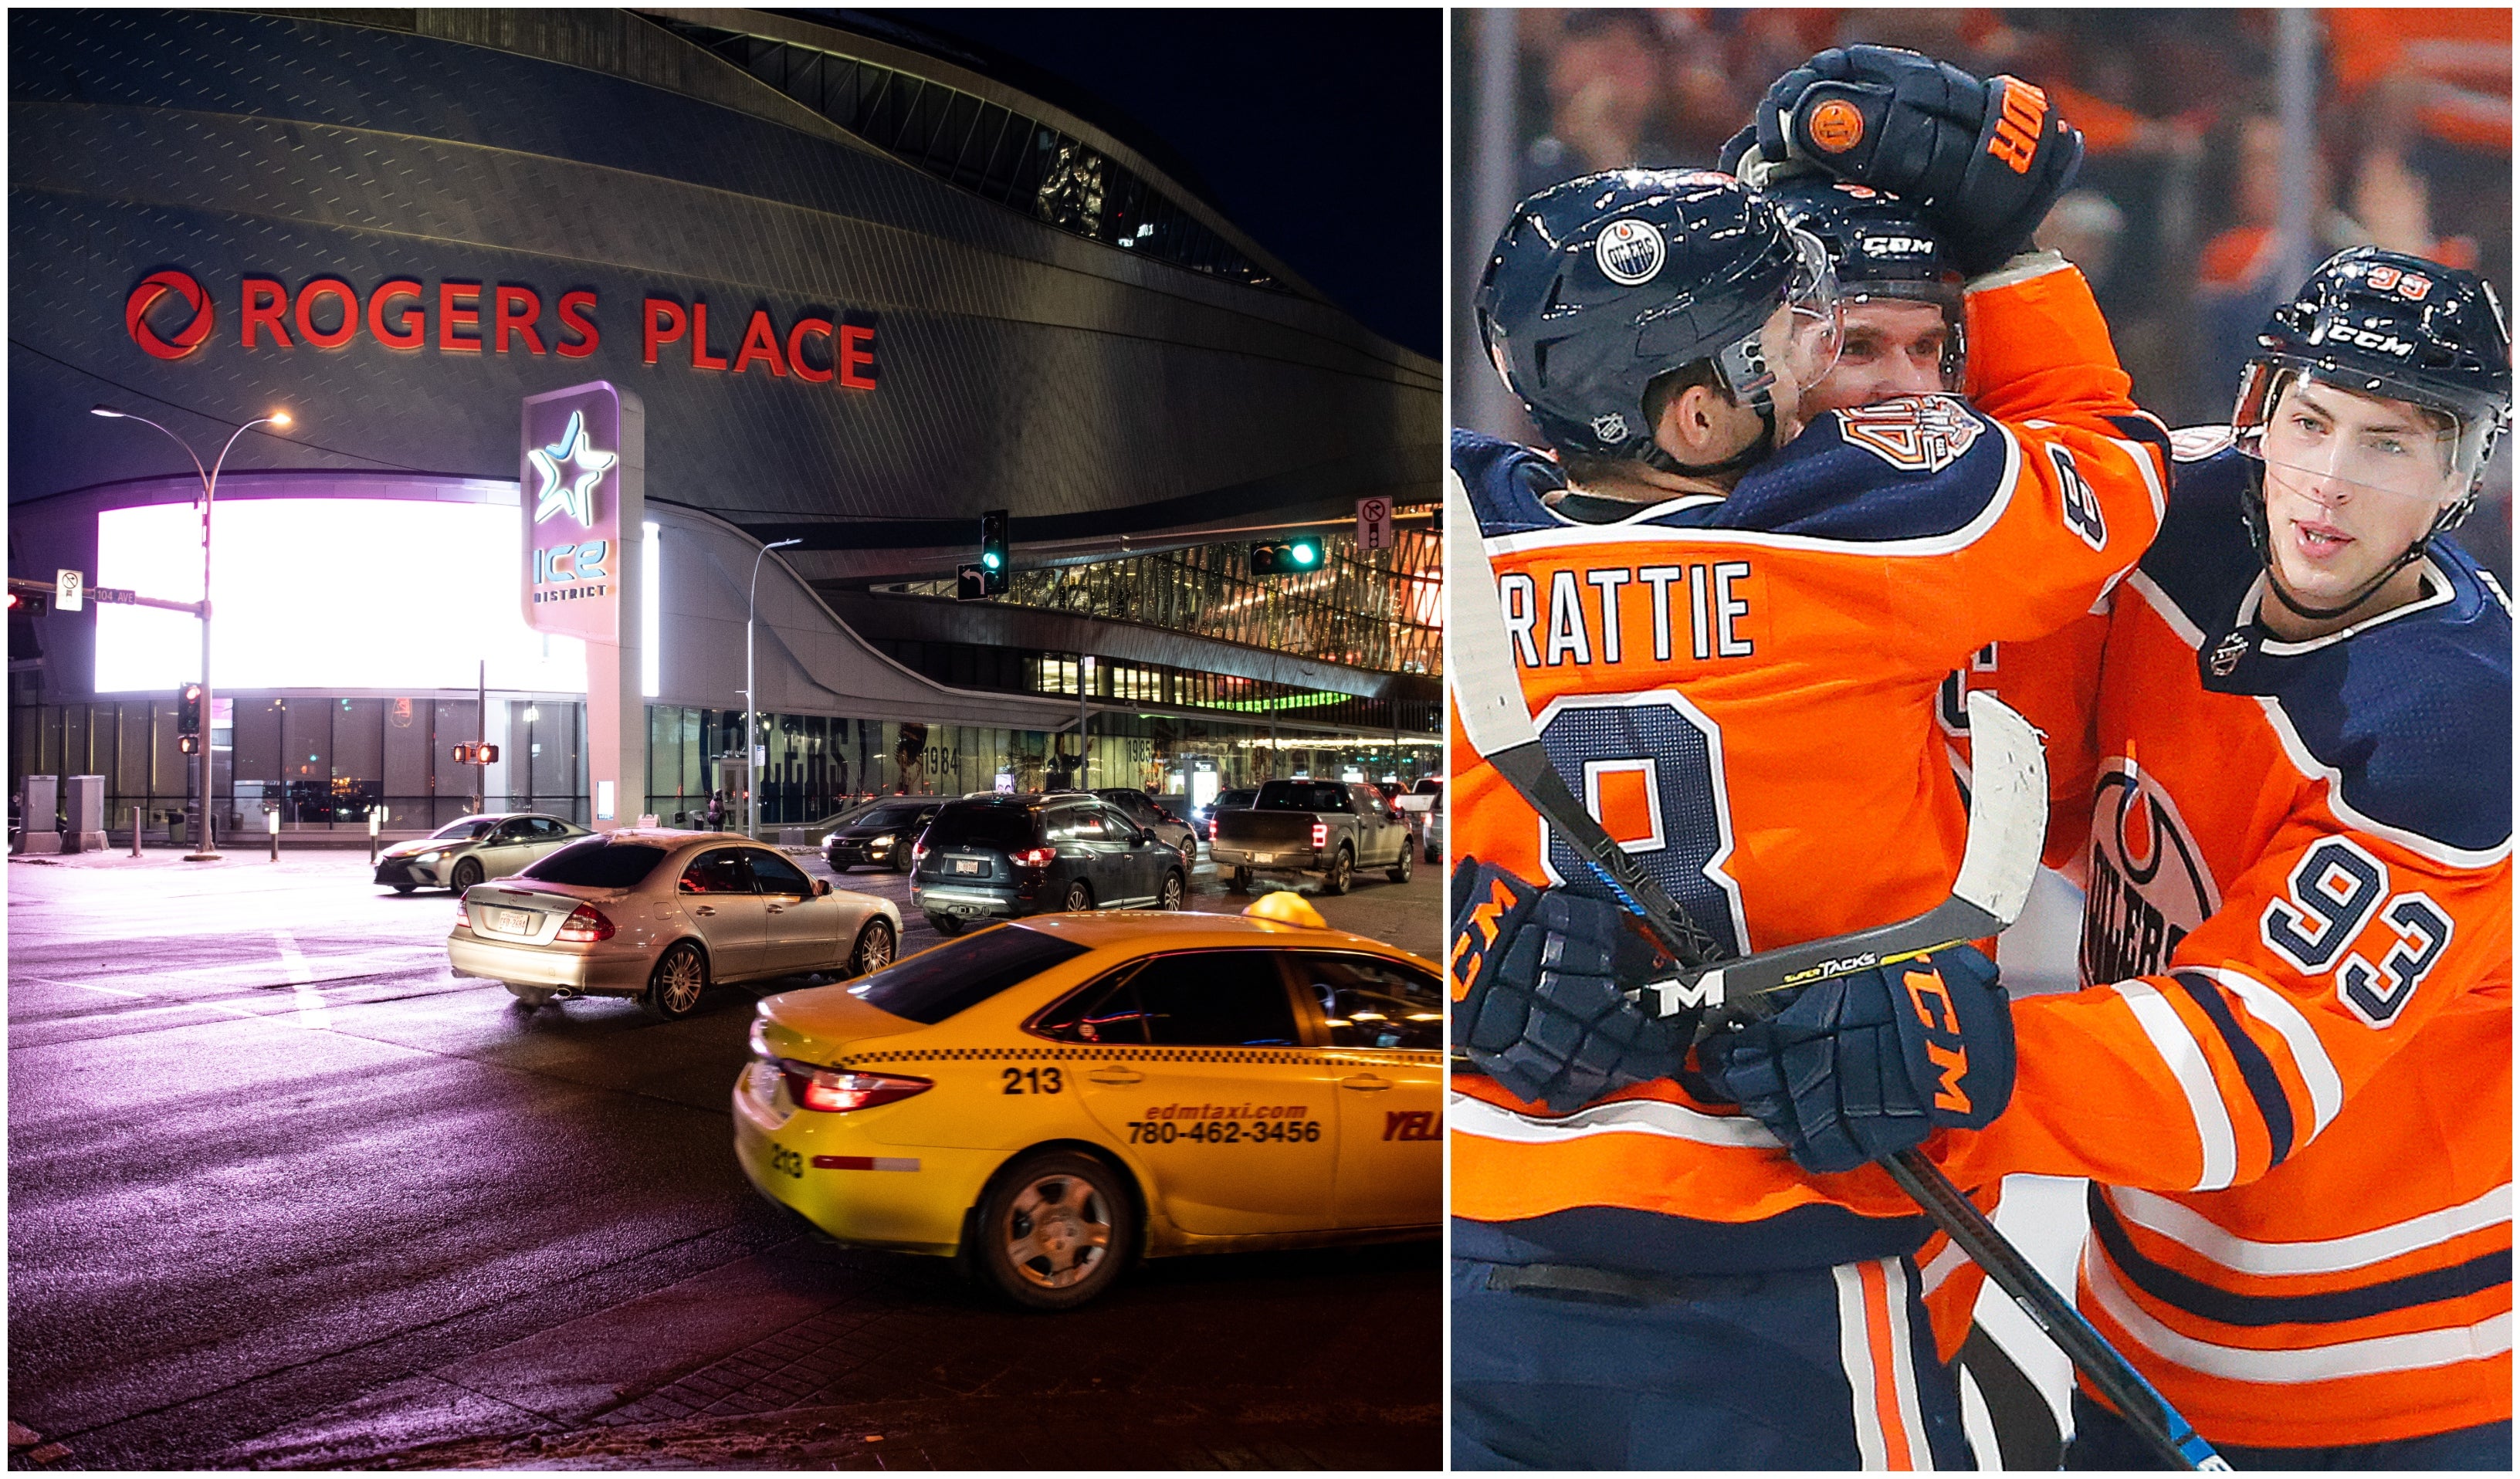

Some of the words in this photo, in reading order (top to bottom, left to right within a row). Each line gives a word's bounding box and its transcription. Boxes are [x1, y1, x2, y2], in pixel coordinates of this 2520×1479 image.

[1862, 237, 1933, 258] CCM
[241, 279, 600, 358] ROGERS
[642, 297, 878, 391] PLACE
[2328, 324, 2413, 357] CCM
[97, 590, 113, 601] 104
[117, 592, 134, 603] AVE
[533, 584, 607, 603] DISTRICT
[1499, 560, 1753, 668] RATTIE
[924, 746, 958, 775] 1984
[1127, 739, 1151, 763] 1985
[1451, 878, 1519, 1003] CM
[2259, 834, 2454, 1030] 93
[1817, 952, 1876, 978] TACKS
[1902, 953, 1973, 1115] CM
[1003, 1067, 1064, 1095] 213
[1145, 1102, 1308, 1120] edmtaxi.com
[1127, 1121, 1321, 1144] 780-462-3456
[774, 1142, 804, 1179] 213
